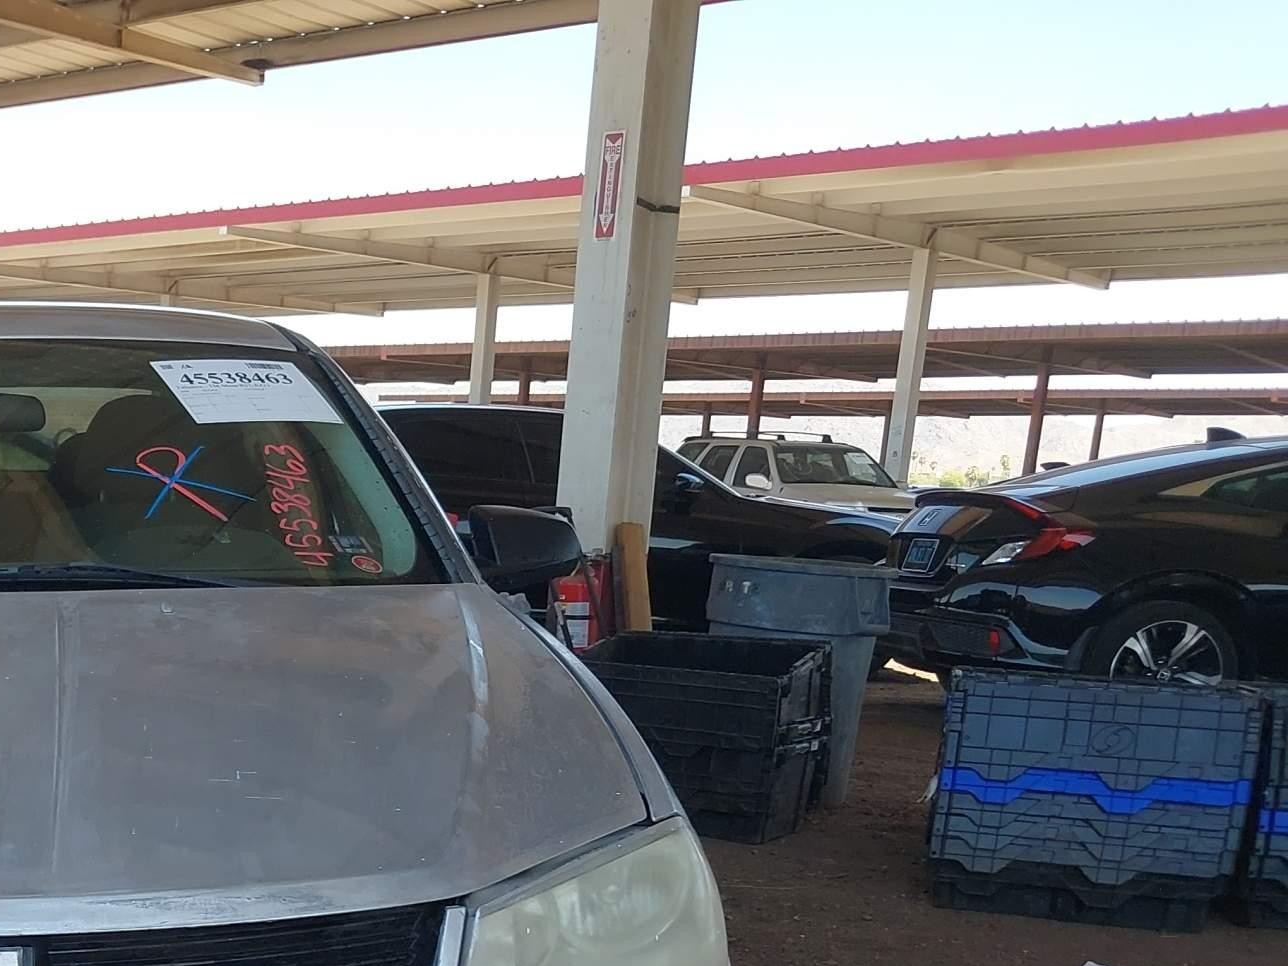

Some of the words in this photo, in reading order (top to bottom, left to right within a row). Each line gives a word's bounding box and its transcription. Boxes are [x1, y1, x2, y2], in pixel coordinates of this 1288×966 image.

[605, 144, 622, 155] FIRE
[180, 371, 293, 385] 45538463
[264, 444, 334, 567] 45538463
